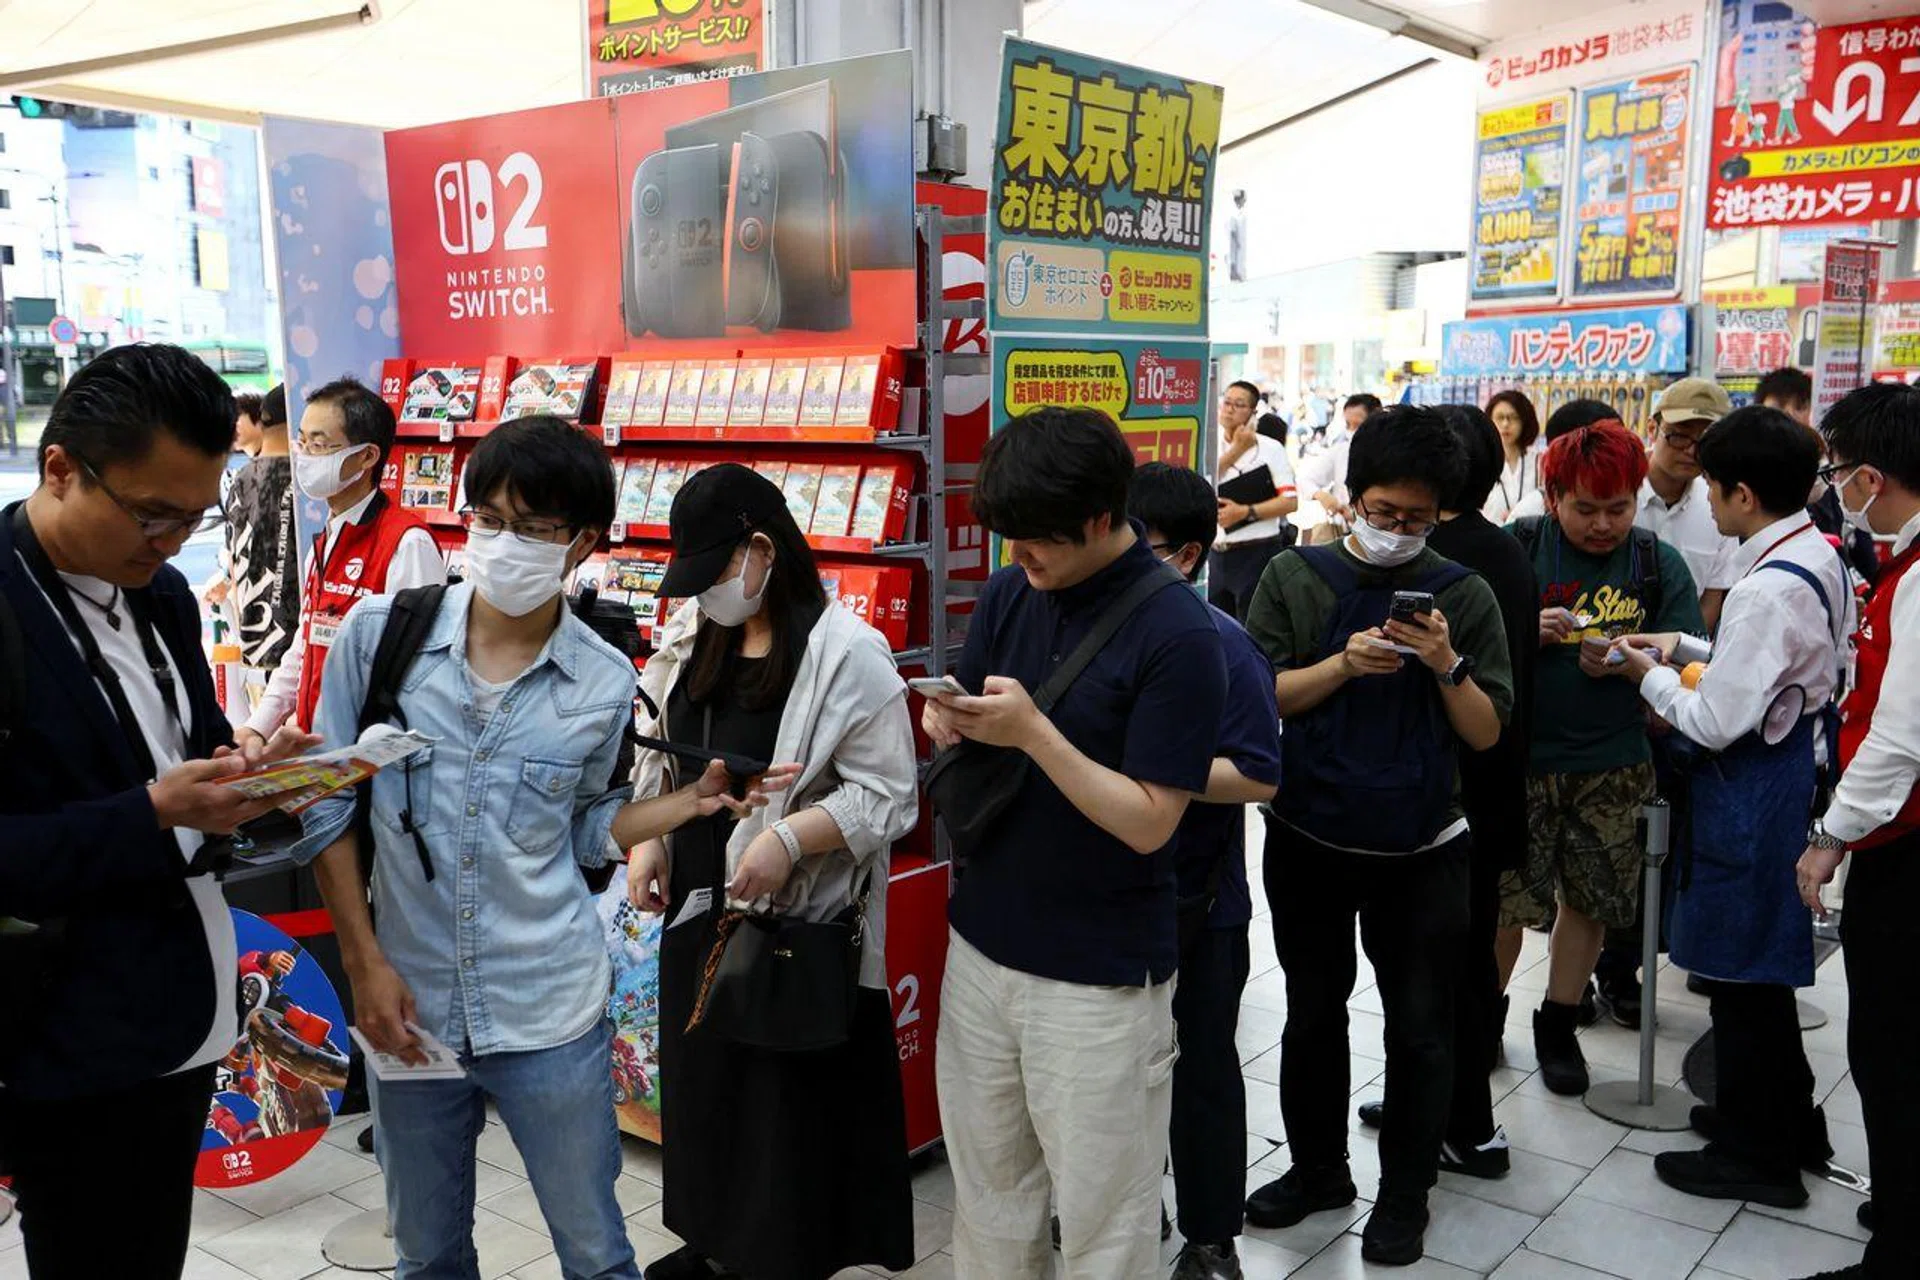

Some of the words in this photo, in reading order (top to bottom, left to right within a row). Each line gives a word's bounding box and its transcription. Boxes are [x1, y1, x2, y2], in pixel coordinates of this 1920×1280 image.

[599, 16, 750, 62] ポイントサービス!!
[1507, 34, 1610, 81] ビックカメラ
[1612, 14, 1694, 57] 池袋本店
[1003, 61, 1206, 198] 東京都に
[497, 151, 547, 251] 2
[1000, 181, 1201, 246] お住まいの方、必見!!
[446, 267, 546, 287] NINTENDO
[1033, 263, 1099, 286] 東京ゼロエミ
[1134, 269, 1193, 289] ビックカメラ
[449, 287, 549, 320] SWITCH
[1044, 288, 1087, 305] ポイント
[1510, 321, 1653, 367] ハンディファン
[391, 378, 401, 393] 2
[492, 377, 501, 392] 2
[1014, 381, 1122, 404] 店頭申請するだけで
[390, 464, 399, 479] 2
[855, 594, 868, 615] 2
[900, 599, 908, 612] 2
[896, 974, 920, 1028] 2
[238, 1151, 252, 1167] 2
